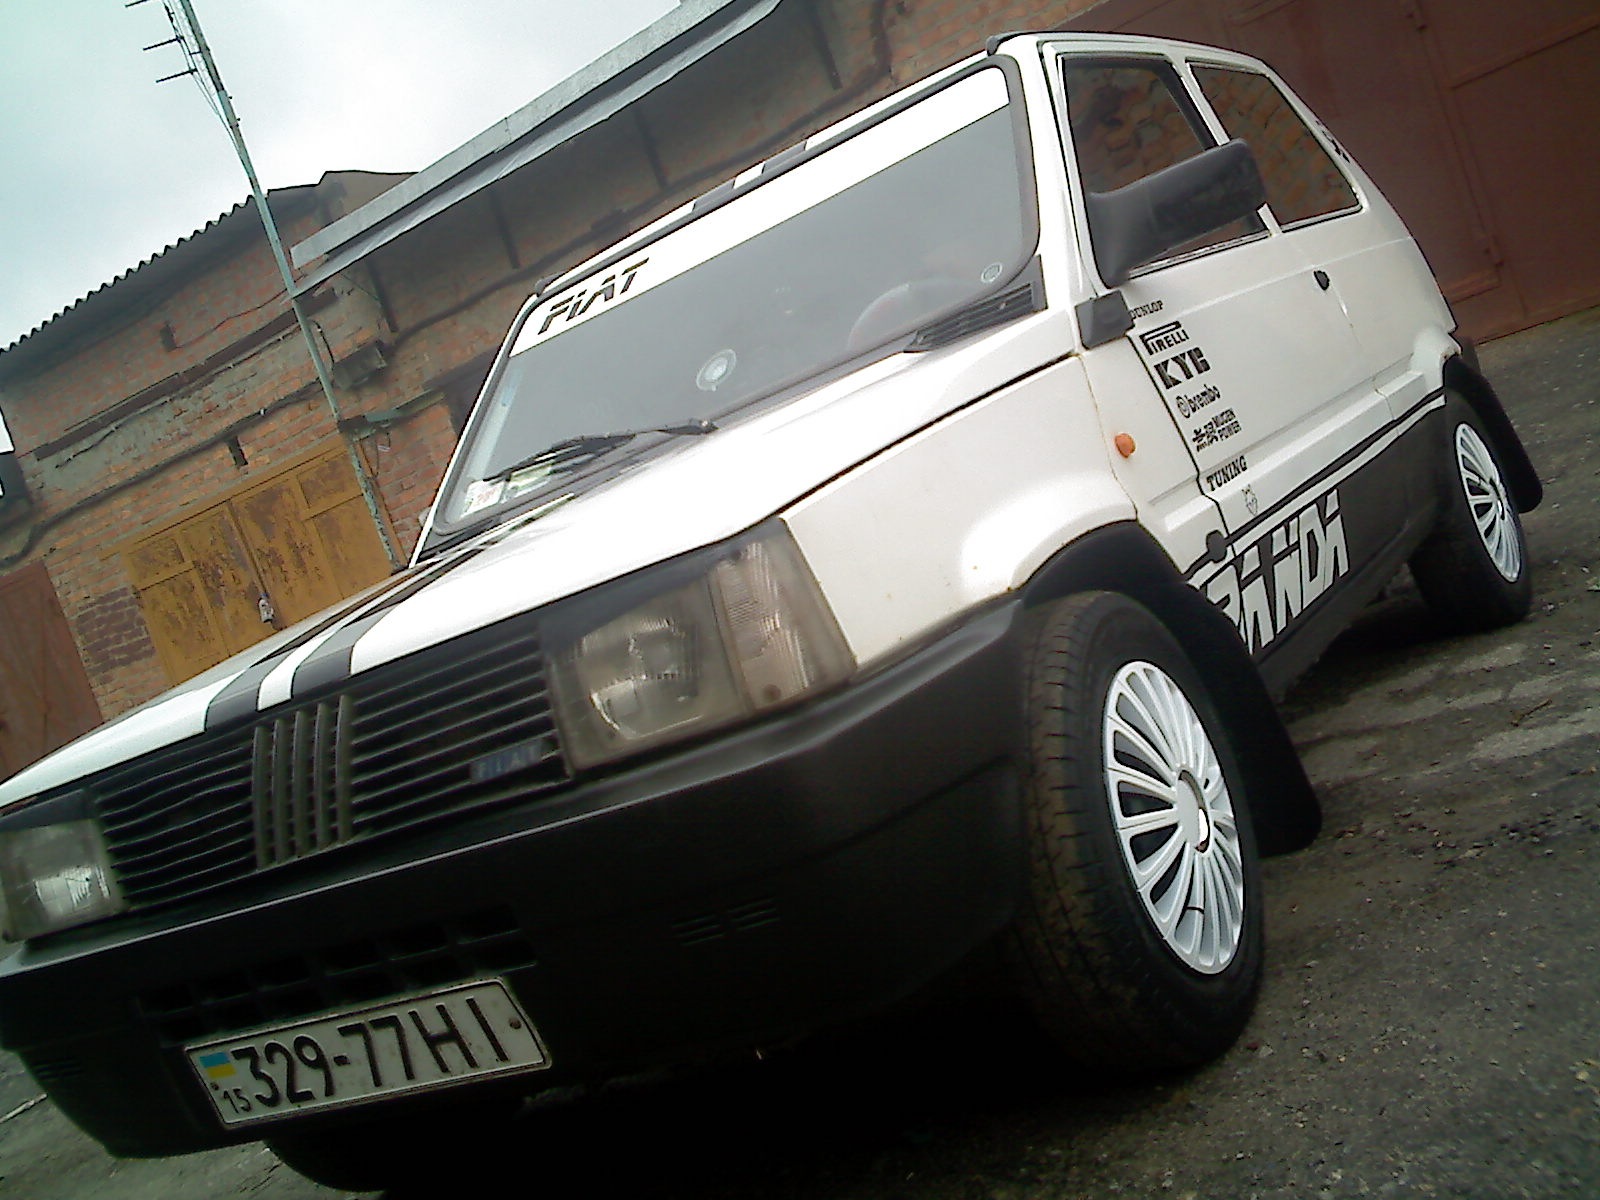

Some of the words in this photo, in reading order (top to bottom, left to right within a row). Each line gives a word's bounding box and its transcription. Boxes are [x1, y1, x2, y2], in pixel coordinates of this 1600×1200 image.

[537, 257, 650, 335] FIAT
[1139, 320, 1190, 355] PIRELLI
[1206, 455, 1248, 492] TUNING
[220, 1088, 252, 1114] 15
